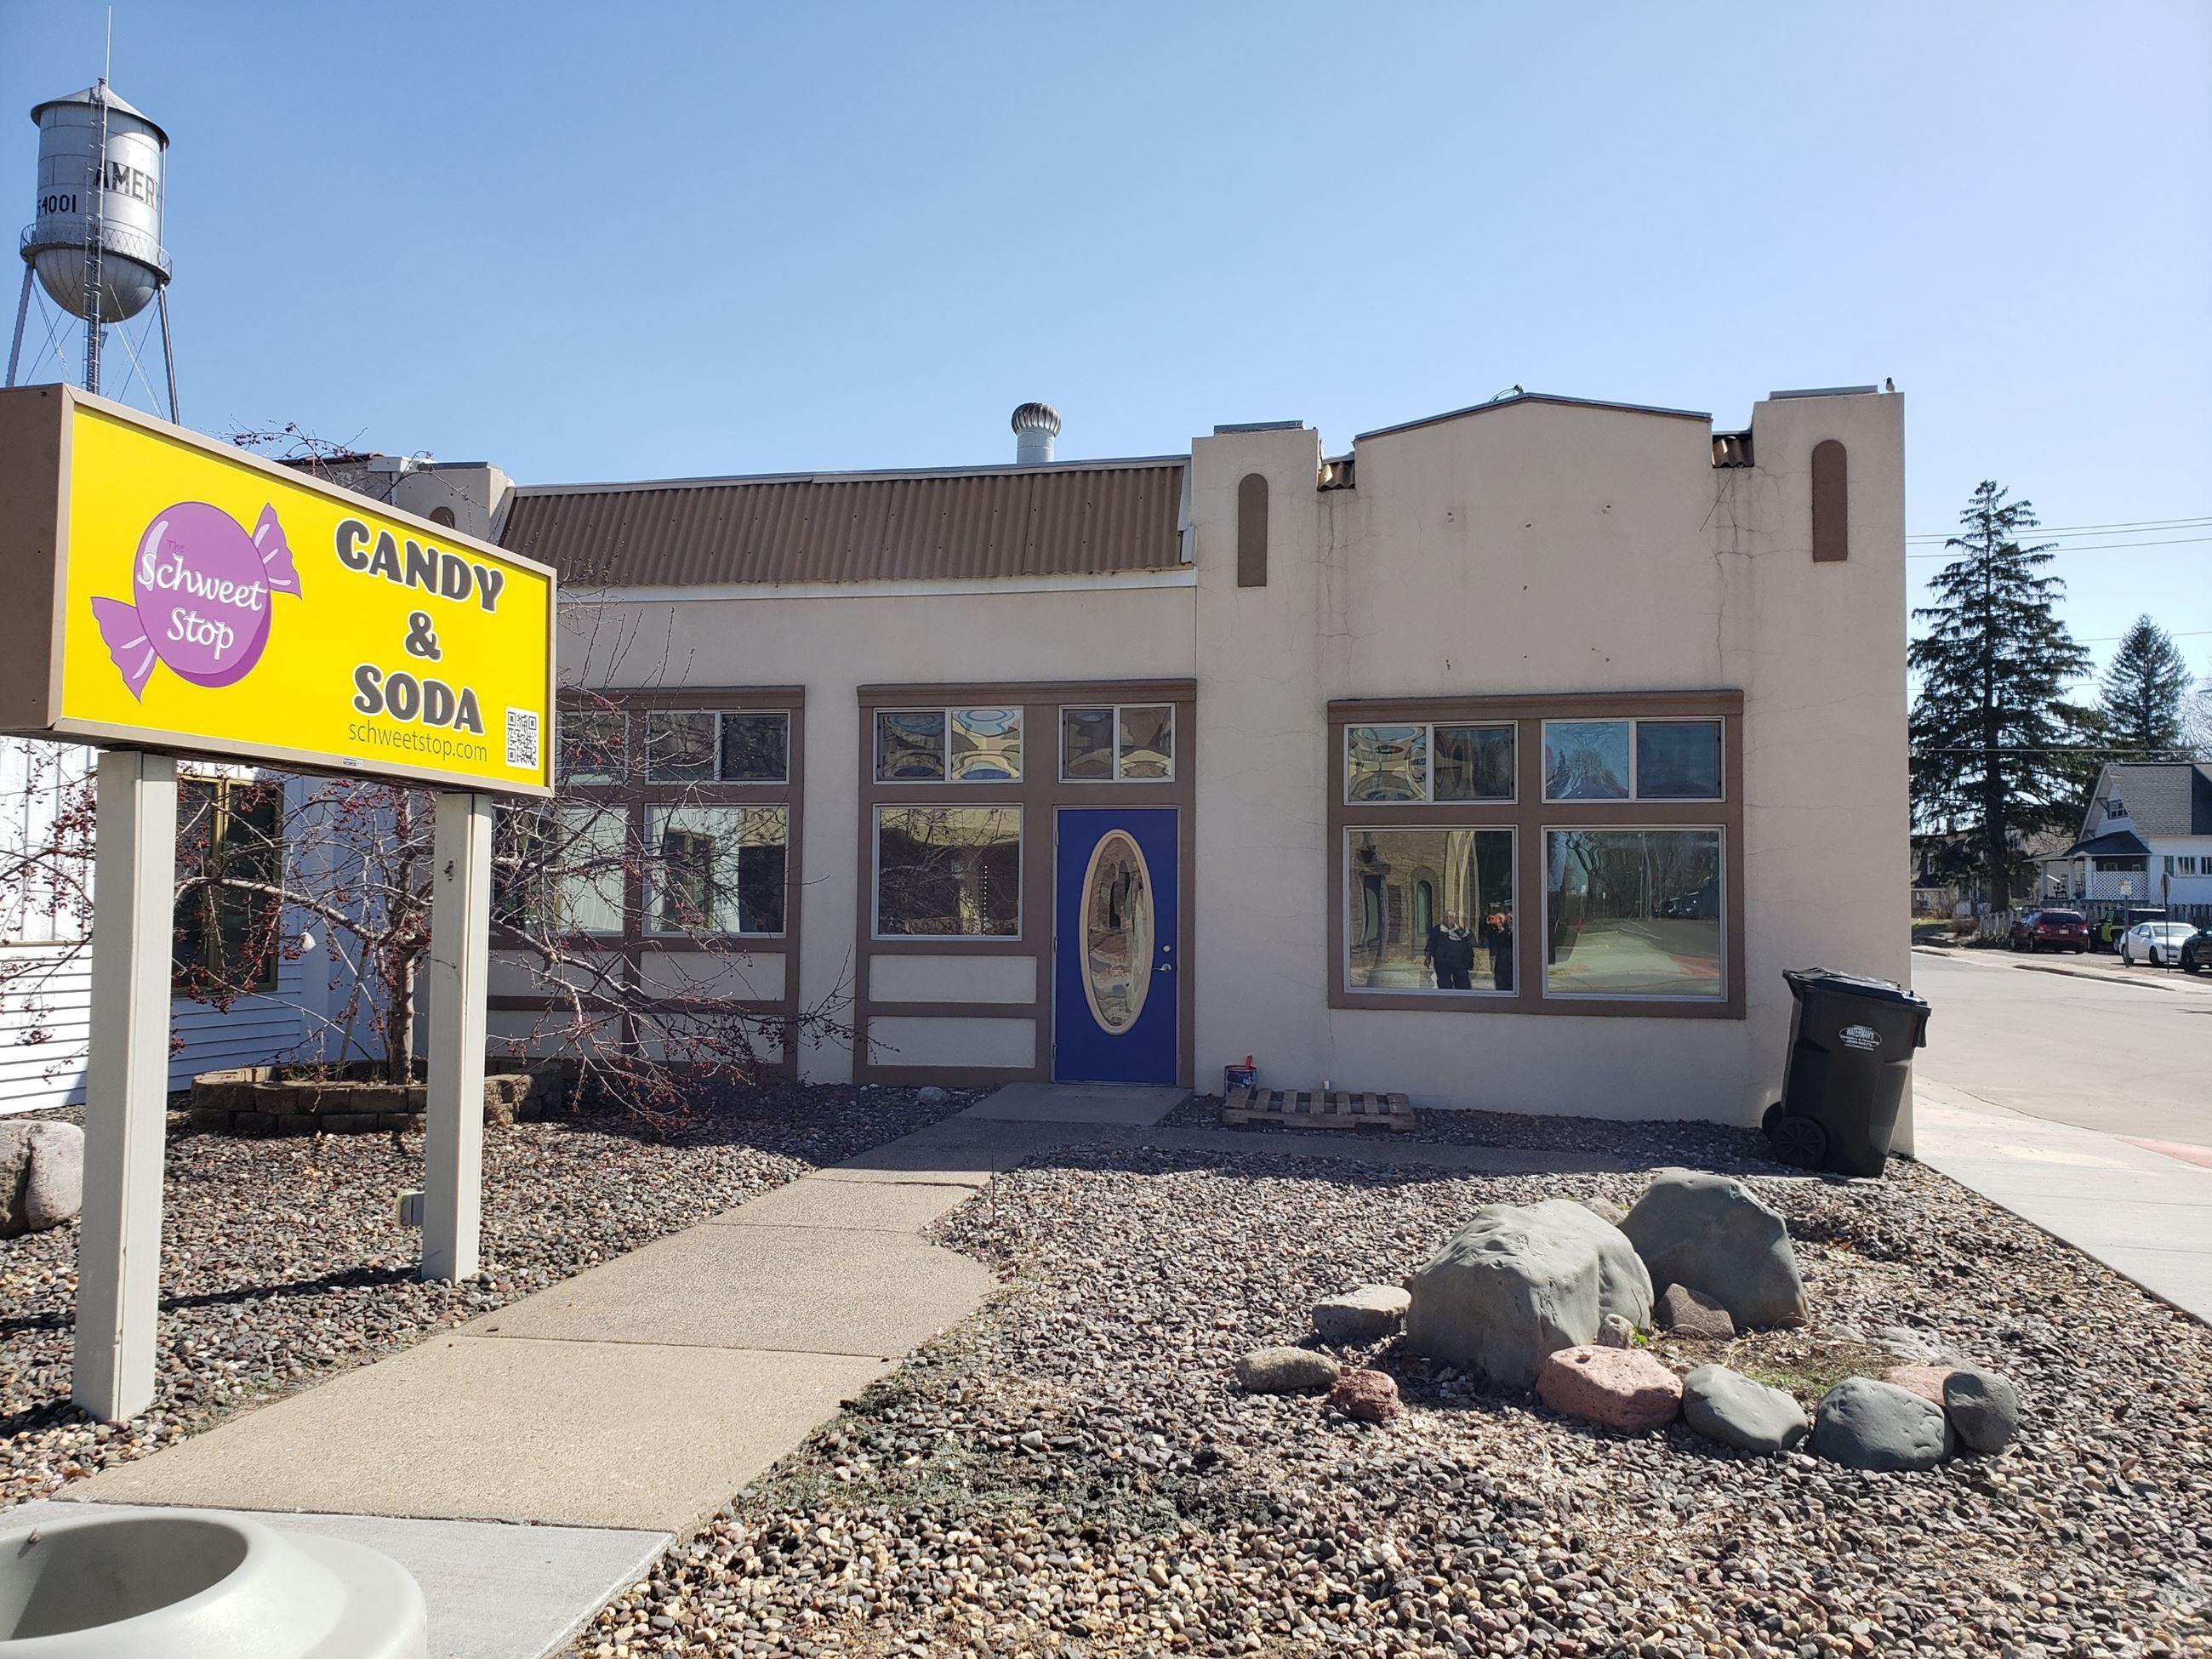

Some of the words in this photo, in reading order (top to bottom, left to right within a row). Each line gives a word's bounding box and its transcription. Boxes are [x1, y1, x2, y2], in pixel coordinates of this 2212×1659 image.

[137, 551, 268, 611] Schweet
[335, 518, 505, 613] CANDY
[167, 607, 235, 660] Stop
[404, 611, 442, 661] &
[353, 664, 485, 735] SODA
[349, 720, 487, 762] schweetstop.com
